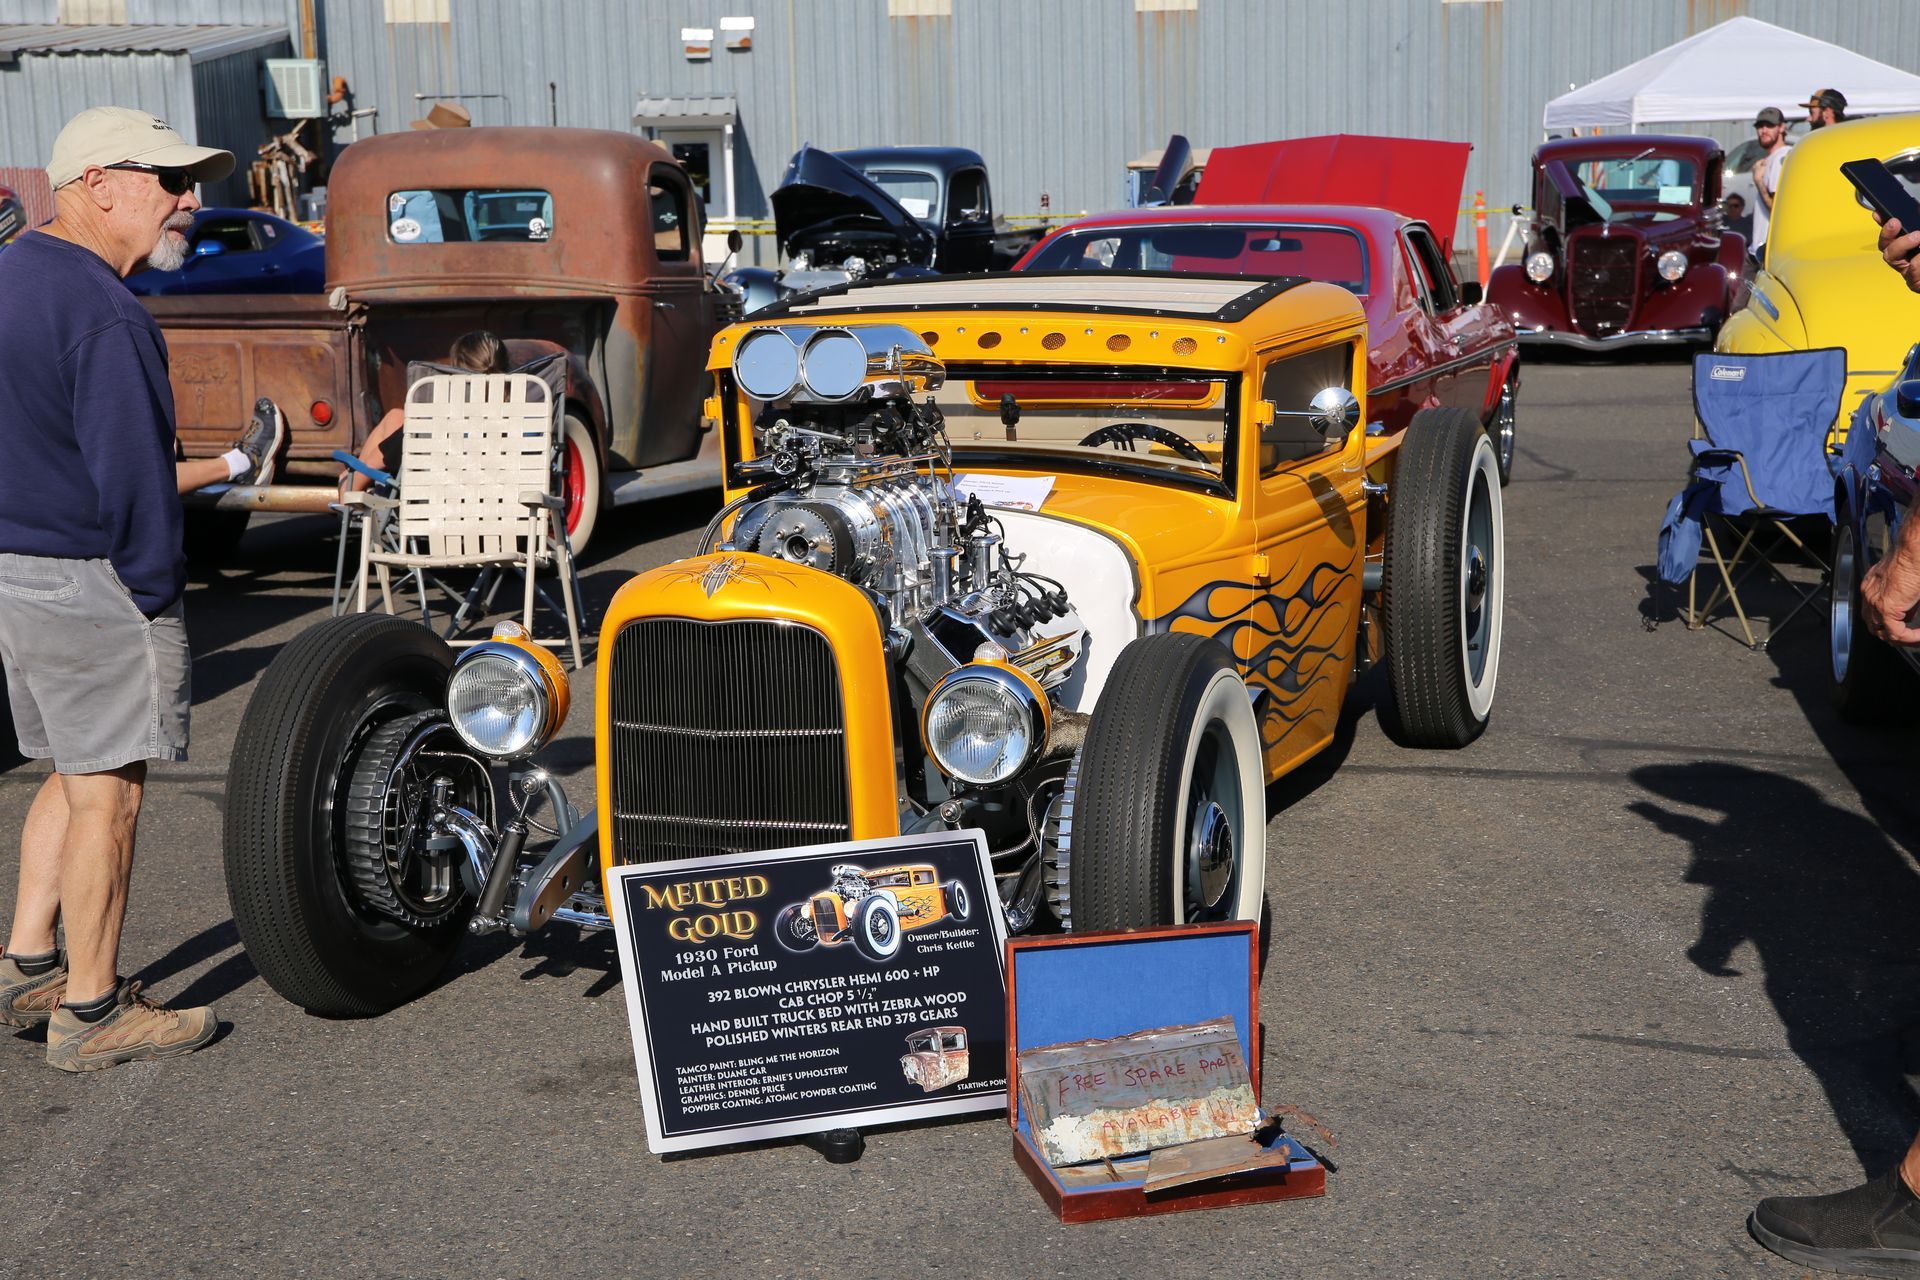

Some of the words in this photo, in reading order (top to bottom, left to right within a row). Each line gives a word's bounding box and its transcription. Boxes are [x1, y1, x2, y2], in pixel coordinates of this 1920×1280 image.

[1714, 368, 1740, 377] Coleman
[640, 875, 769, 911] MELTED
[668, 911, 758, 944] GOLD
[907, 928, 980, 943] Owner/Builder:
[675, 949, 718, 965] 1930
[723, 944, 759, 960] Ford
[917, 943, 943, 954] Chris
[946, 939, 975, 951] Kettle
[661, 965, 705, 983] Model
[711, 964, 722, 976] A
[727, 959, 778, 975] Pickup
[708, 990, 732, 1003] 392
[734, 984, 782, 1000] BLOWN
[785, 976, 847, 994] CHRYSLER
[849, 972, 882, 986] HEMI
[885, 969, 910, 982] 600
[912, 969, 920, 978] +
[922, 965, 941, 977] HP
[779, 996, 804, 1009] CAB
[807, 990, 845, 1005] CHOP
[847, 990, 855, 1001] 5
[690, 1019, 731, 1035] HAND
[734, 1014, 769, 1030] BUILT
[771, 1009, 815, 1024] TRUCK
[818, 1006, 842, 1019] BED
[844, 1002, 879, 1016] WITH
[882, 997, 922, 1012] ZEBRA
[924, 992, 967, 1006] WOOD
[706, 1029, 769, 1048] POLISHED
[771, 1022, 828, 1039] WINTERS
[831, 1018, 863, 1033] REAR
[866, 1015, 892, 1028] END
[895, 1012, 917, 1025] 378
[919, 1007, 959, 1022] GEARS
[676, 1064, 707, 1075] TAMCO
[709, 1060, 737, 1071] PAINT:
[738, 1056, 764, 1068] BLING
[765, 1055, 779, 1064] ME
[780, 1052, 797, 1062] THE
[798, 1048, 840, 1059] HORIZON
[677, 1074, 716, 1085] PAINTER:
[717, 1070, 748, 1080] DUANE
[750, 1067, 767, 1075] CAR
[679, 1083, 716, 1094] LEATHER
[718, 1078, 761, 1089] INTERIOR:
[762, 1073, 793, 1084] ERNIE'S
[795, 1065, 849, 1080] UPHOLSTERY
[957, 1080, 989, 1091] STARTING
[990, 1079, 1007, 1087] POIN
[1058, 1072, 1107, 1106] FREE
[1125, 1063, 1186, 1087] SPARE
[681, 1092, 726, 1105] GRAPHICS:
[728, 1088, 760, 1099] DENNIS
[761, 1084, 785, 1093] PRICE
[682, 1102, 721, 1114] POWDER
[722, 1097, 764, 1109] COATING:
[765, 1092, 799, 1104] ATOMIC
[800, 1086, 838, 1099] POWDER
[839, 1082, 877, 1094] COATING
